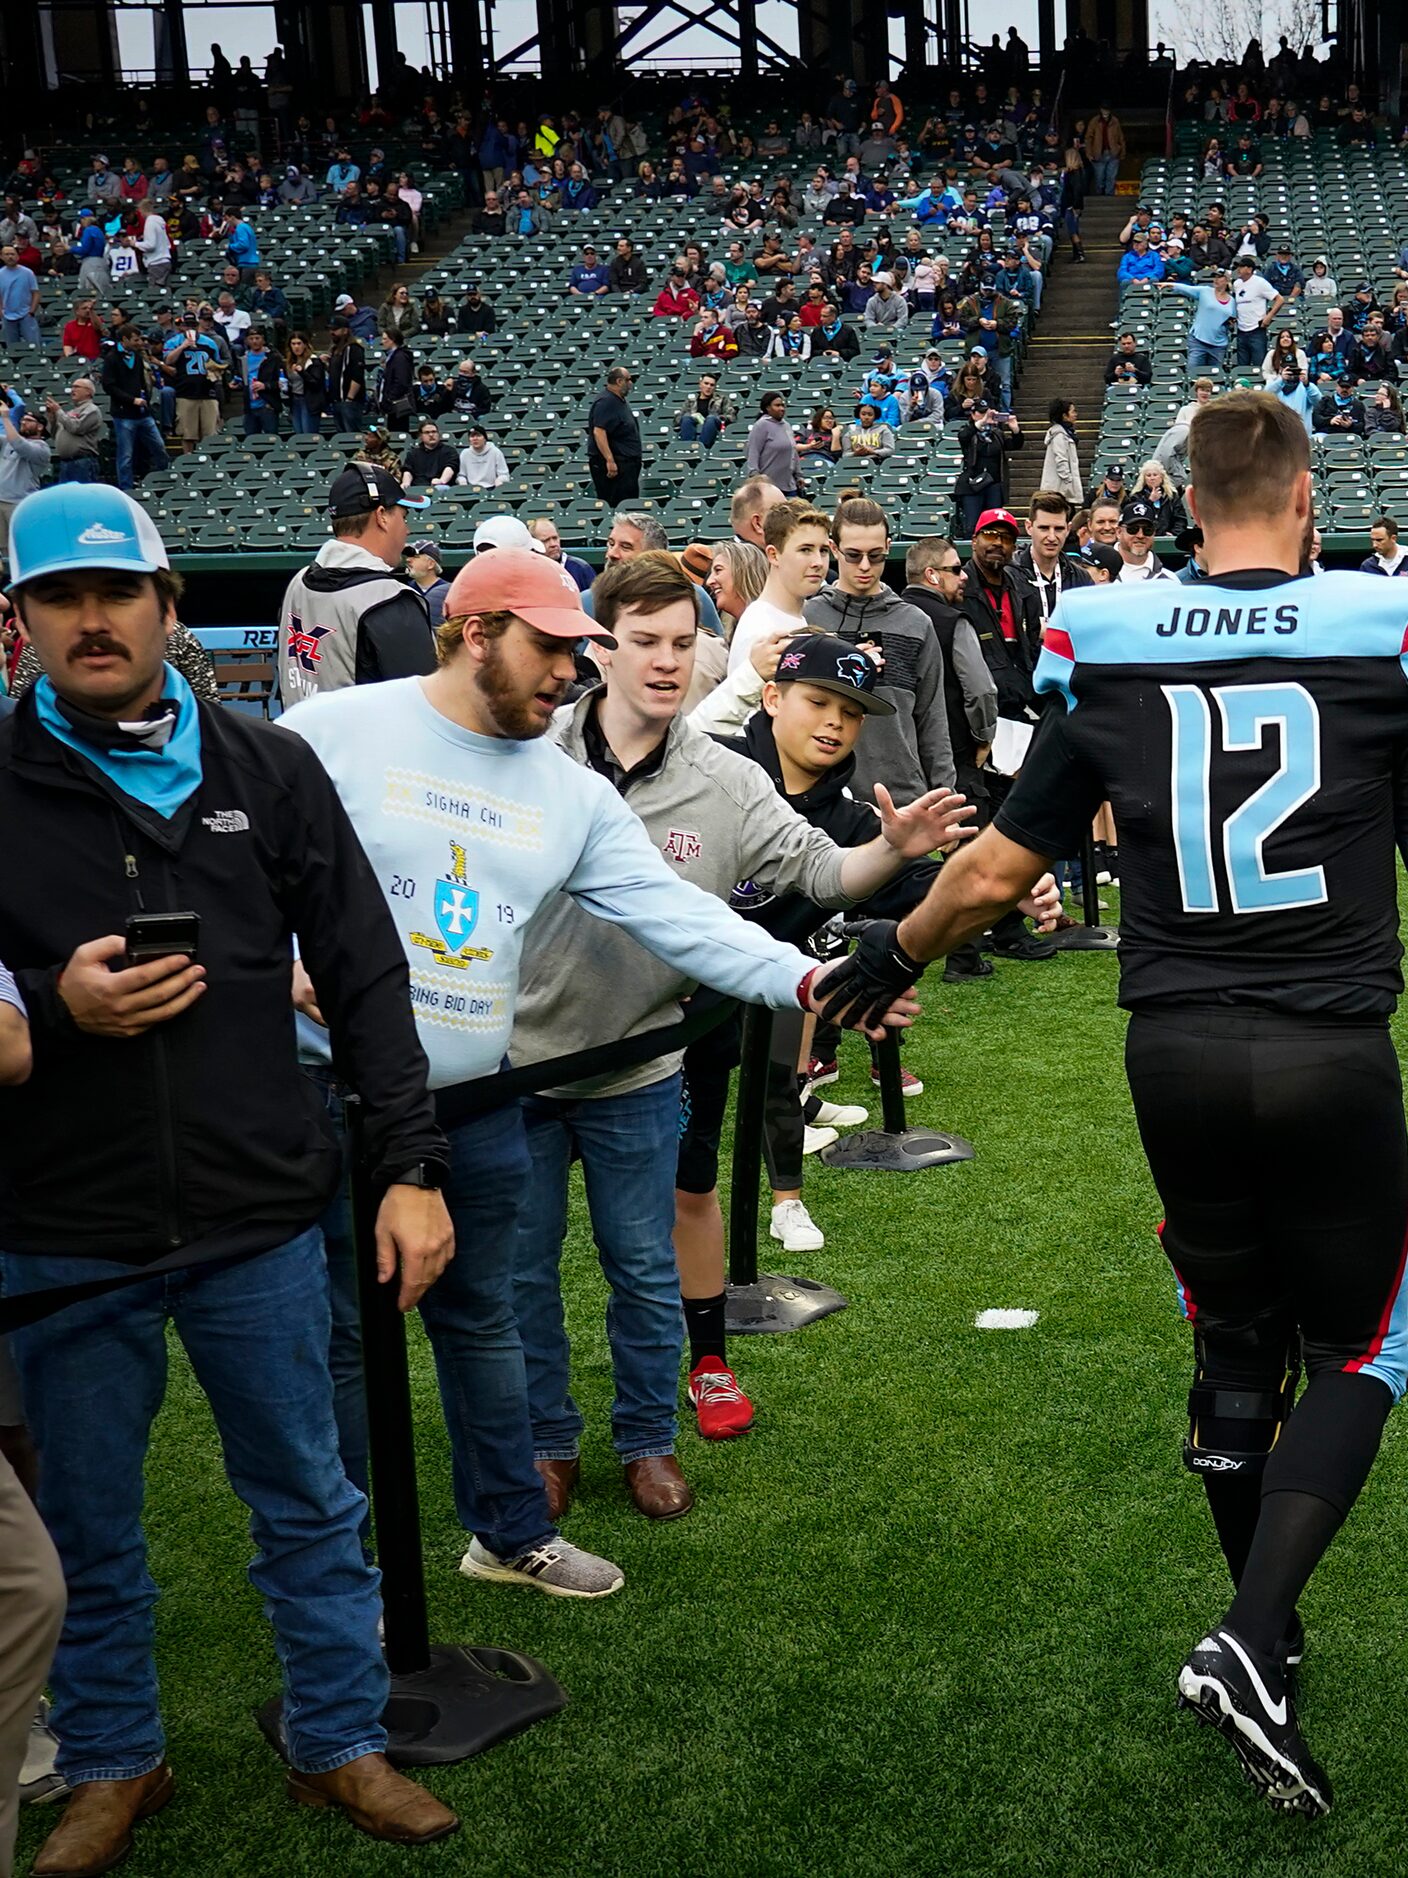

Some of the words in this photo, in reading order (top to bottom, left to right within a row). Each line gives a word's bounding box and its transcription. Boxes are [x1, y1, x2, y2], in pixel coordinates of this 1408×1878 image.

[116, 256, 132, 271] 21
[188, 350, 209, 375] 20
[1156, 605, 1299, 637] JONES
[426, 791, 470, 819] SIGMA
[480, 807, 502, 829] CHI
[1160, 681, 1329, 915] 12
[202, 817, 234, 827] NORTH
[390, 875, 416, 899] 20
[496, 903, 515, 924] 19
[444, 994, 466, 1012] BID
[469, 999, 493, 1016] DAY
[1193, 1457, 1244, 1470] DONJOY
